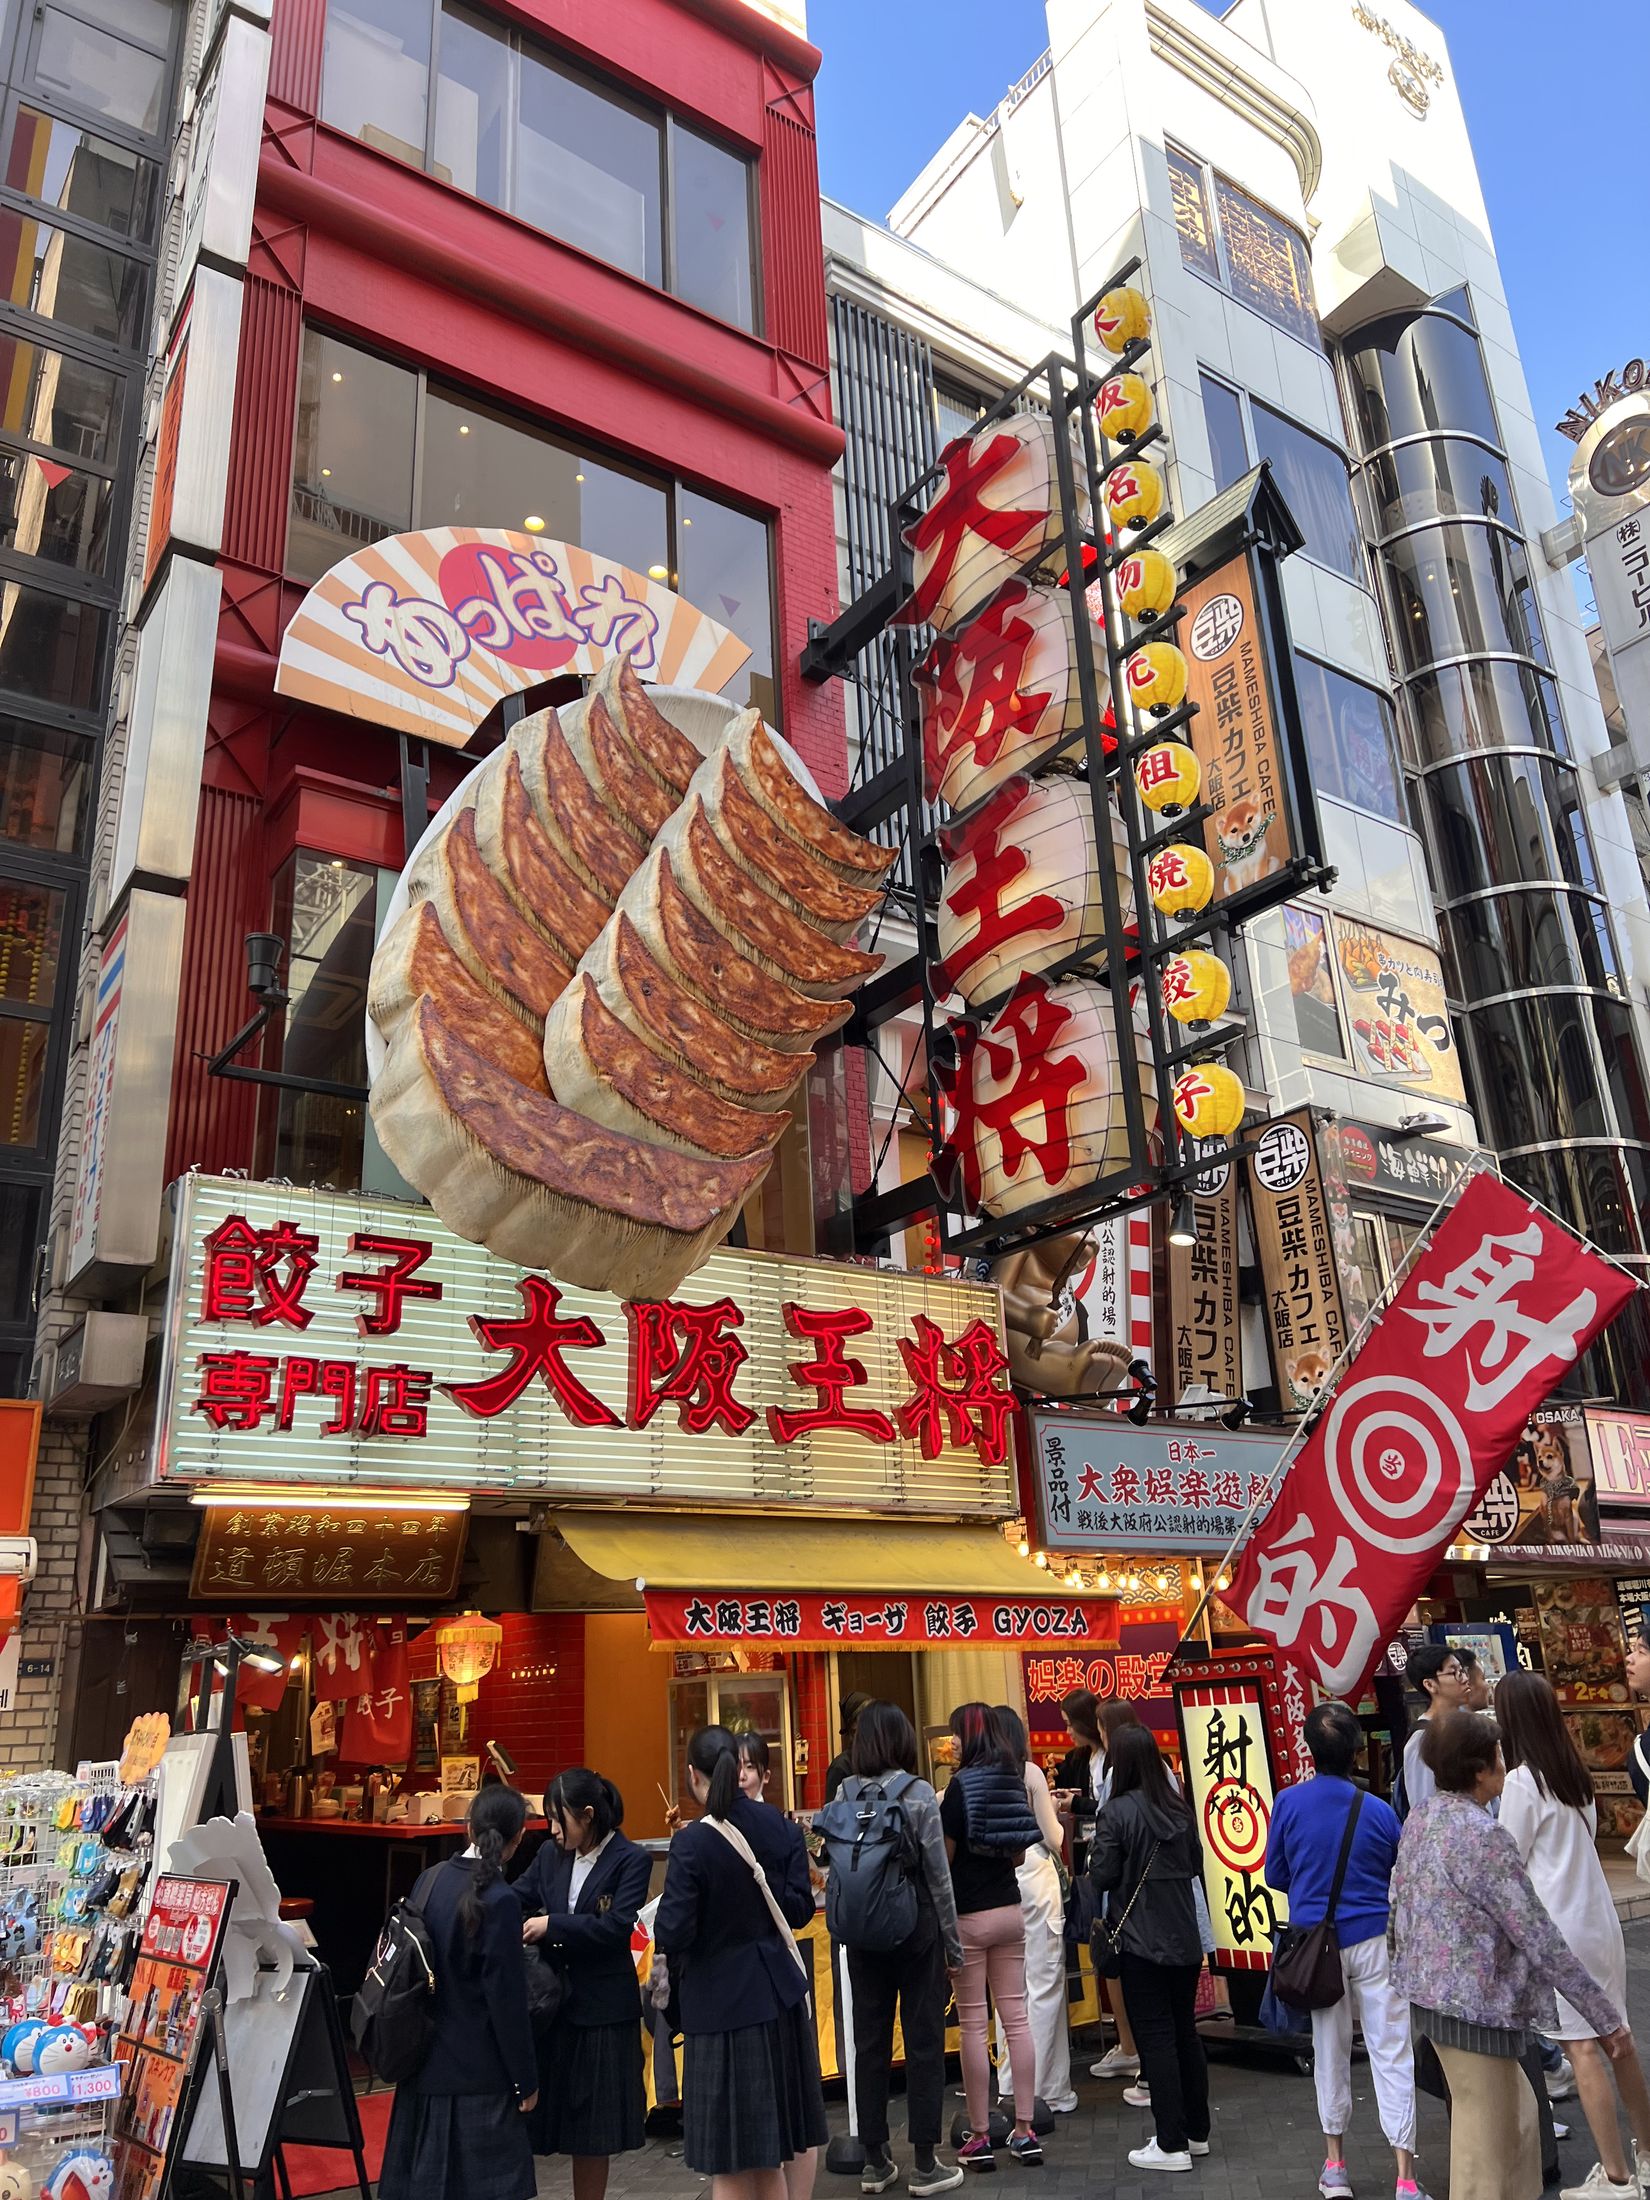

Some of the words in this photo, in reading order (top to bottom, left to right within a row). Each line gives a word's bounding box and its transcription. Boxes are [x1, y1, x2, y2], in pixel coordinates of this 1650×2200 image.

[1554, 358, 1650, 444] NIKO
[1240, 640, 1267, 755] MAMESHIBA
[1257, 758, 1276, 814] CAFE
[1276, 1176, 1294, 1187] CAFE
[202, 1214, 443, 1337] 餃子
[1220, 1198, 1233, 1327] MAMESHIBA
[1304, 1178, 1335, 1303] MAMESHIBA
[1325, 1309, 1348, 1368] CAFE
[1272, 1289, 1295, 1350] 大阪店
[191, 1351, 433, 1439] 専門店
[436, 1274, 1021, 1468] 大阪王将
[1223, 1336, 1235, 1397] CAFE
[1535, 1408, 1581, 1425] OSAKA
[1044, 1436, 1071, 1523] 景品付
[1167, 1440, 1217, 1465] 日本一
[1075, 1462, 1286, 1512] 大衆娯楽遊戯
[1480, 1529, 1500, 1537] CAFE
[208, 1546, 447, 1590] 道頓堀本店
[1619, 1592, 1650, 1603] 本場大阪
[684, 1598, 801, 1637] 大阪王将
[821, 1601, 907, 1636] ギョーザ
[925, 1603, 978, 1638] 餃子
[992, 1606, 1089, 1636] GYOZA
[1574, 1681, 1597, 1700] 2F
[1203, 1708, 1253, 1789] 射
[1208, 1787, 1262, 1817] 大当り
[1224, 1869, 1276, 1946] 的
